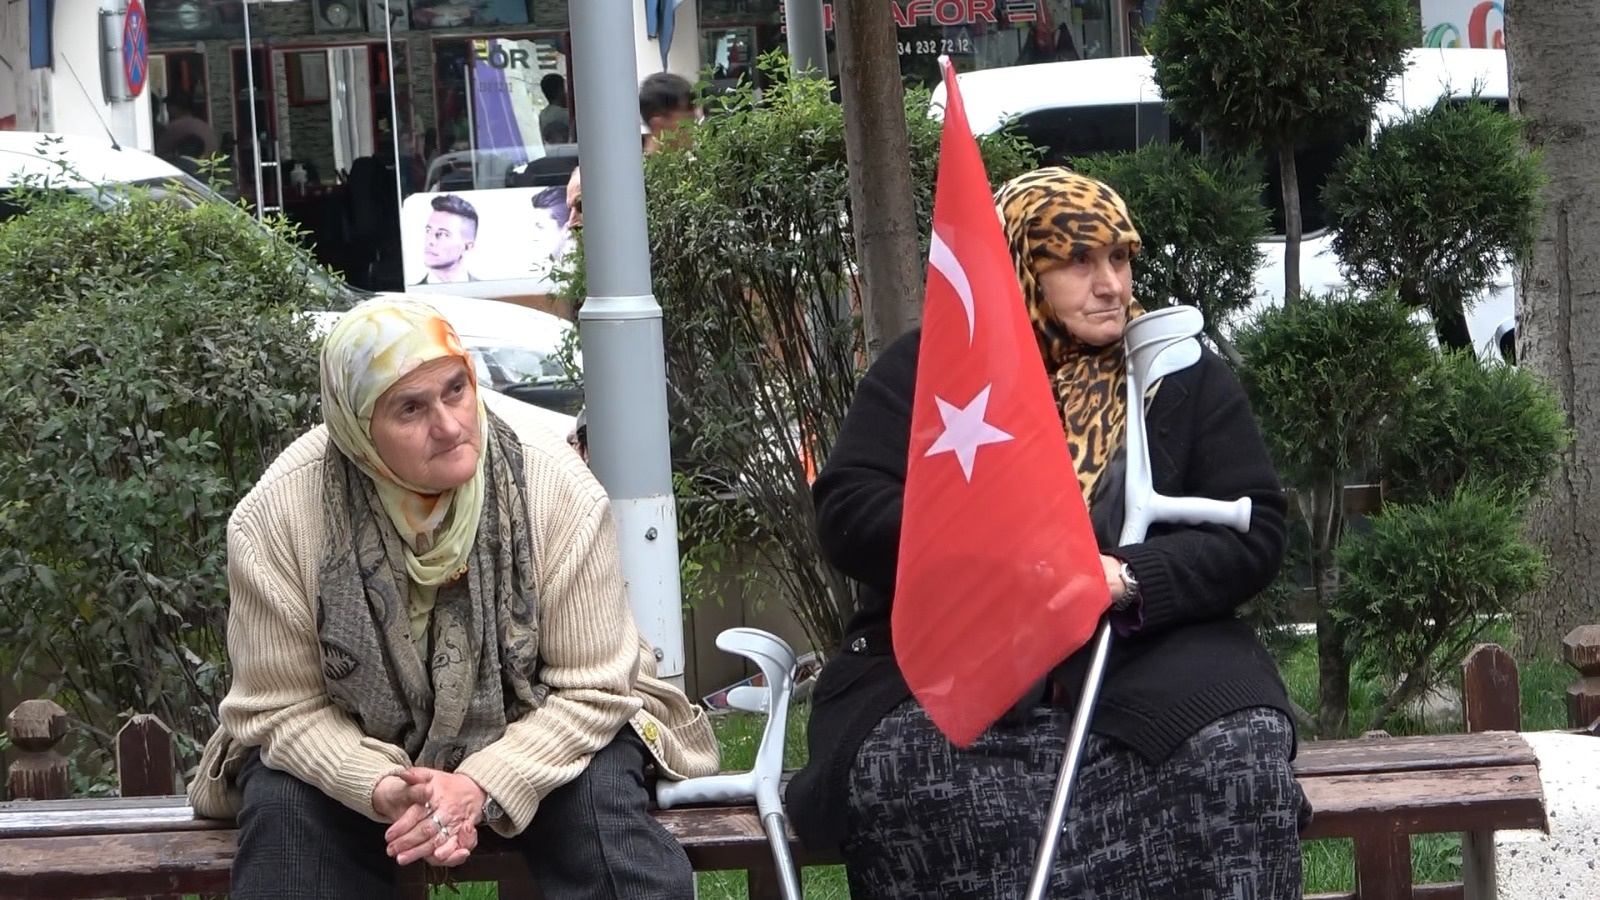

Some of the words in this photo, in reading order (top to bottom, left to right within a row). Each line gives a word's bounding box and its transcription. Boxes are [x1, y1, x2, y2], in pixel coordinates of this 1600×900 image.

[916, 41, 936, 54] 232
[940, 39, 954, 52] 72
[958, 39, 969, 51] 12
